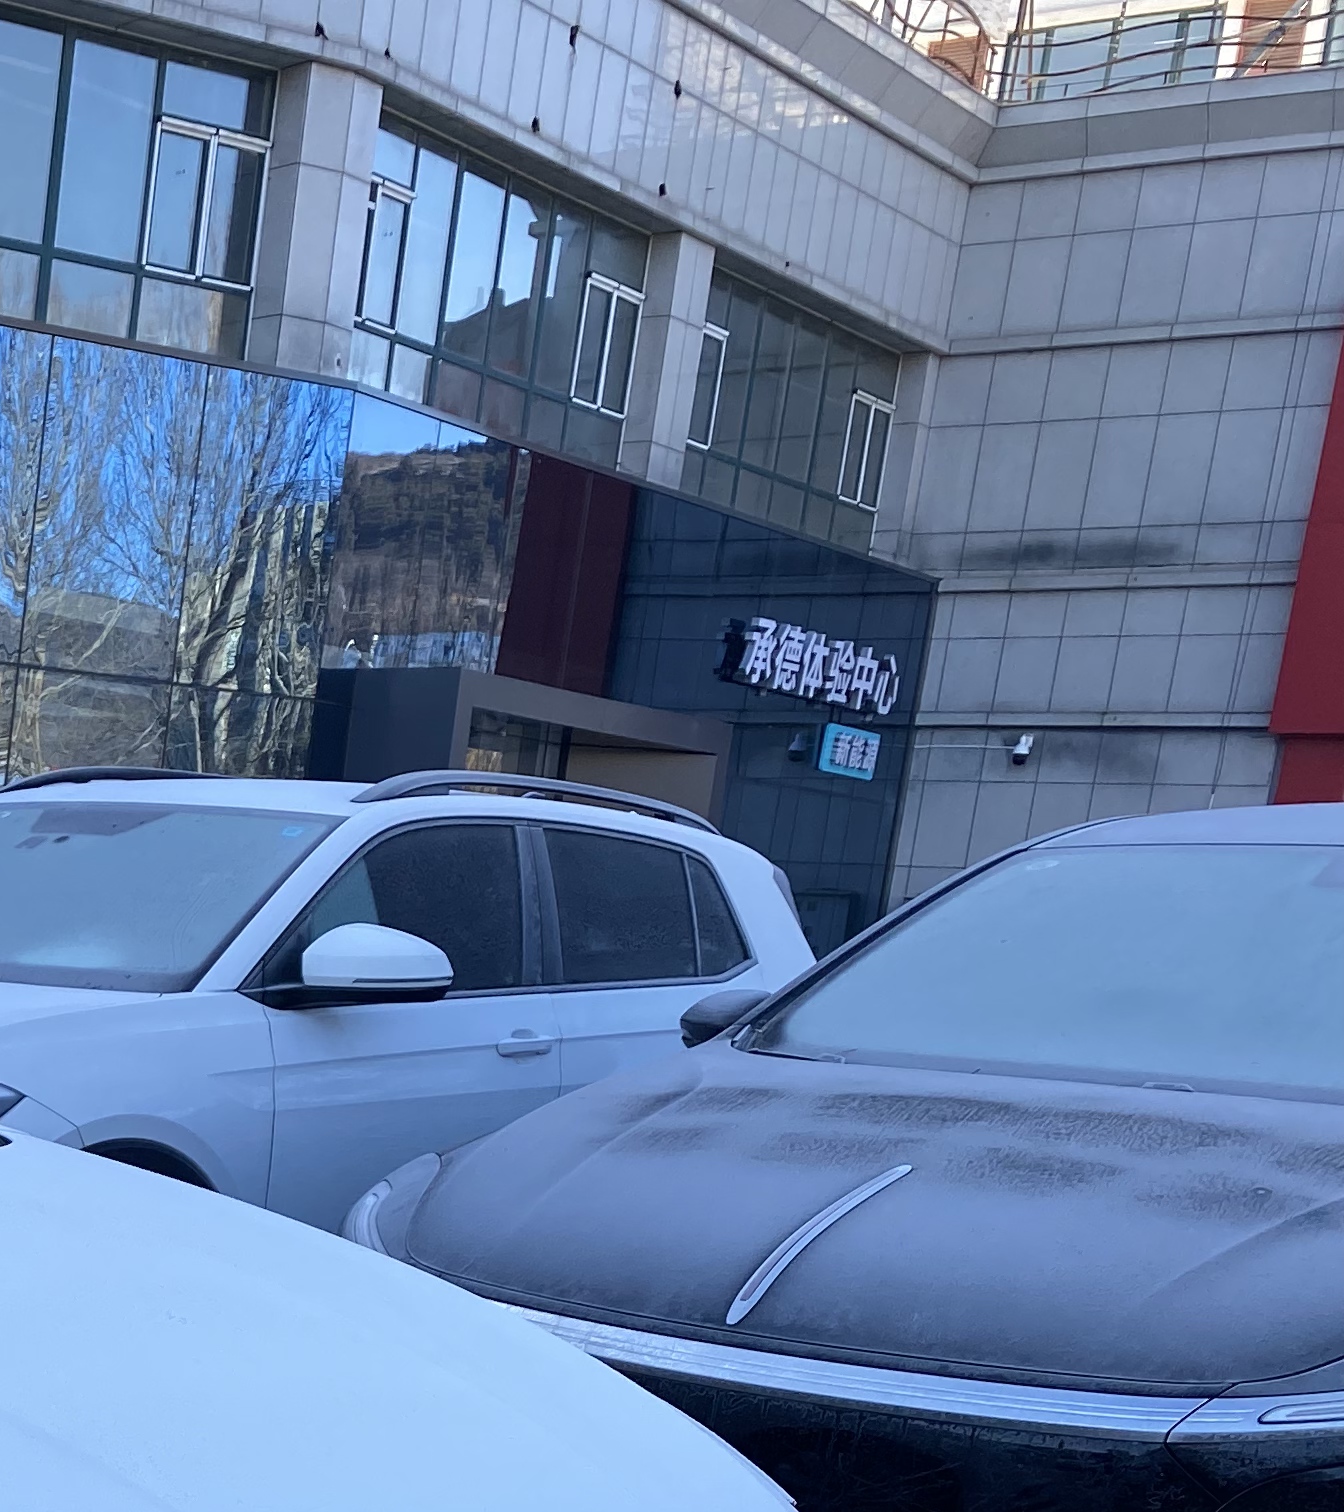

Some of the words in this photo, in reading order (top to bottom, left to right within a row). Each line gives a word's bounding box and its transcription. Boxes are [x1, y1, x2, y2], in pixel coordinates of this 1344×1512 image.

[742, 616, 901, 716] 承德体验中心
[834, 732, 879, 772] 新能源
